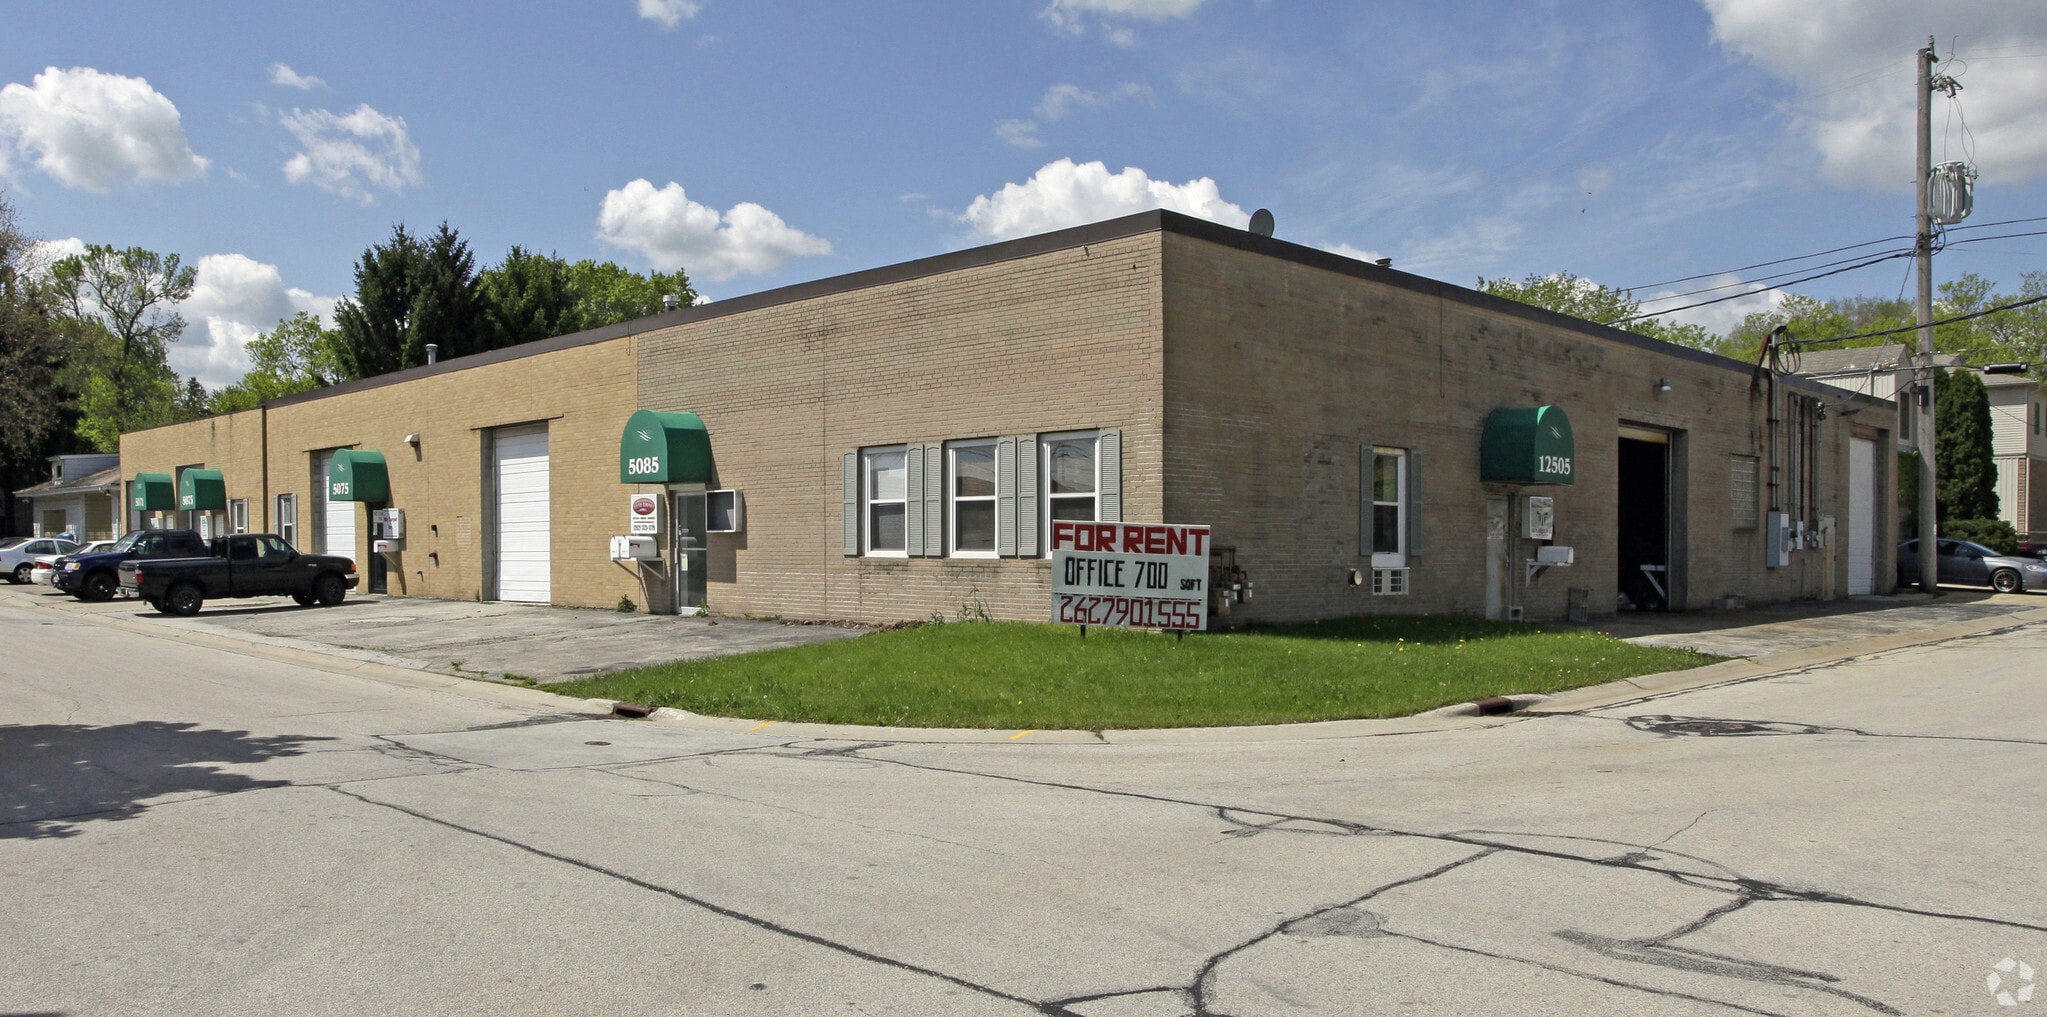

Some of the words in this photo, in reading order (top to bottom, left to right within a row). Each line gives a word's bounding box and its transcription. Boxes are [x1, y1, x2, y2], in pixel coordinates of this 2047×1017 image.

[629, 456, 659, 474] 5085
[1539, 455, 1571, 474] 12505
[332, 482, 349, 495] 5075
[1053, 523, 1117, 552] FOR
[1123, 526, 1210, 556] RENT
[1065, 557, 1125, 587] OFFICE
[1134, 561, 1168, 589] 700
[1180, 579, 1202, 591] SQFT
[1060, 595, 1201, 629] 2627901555
